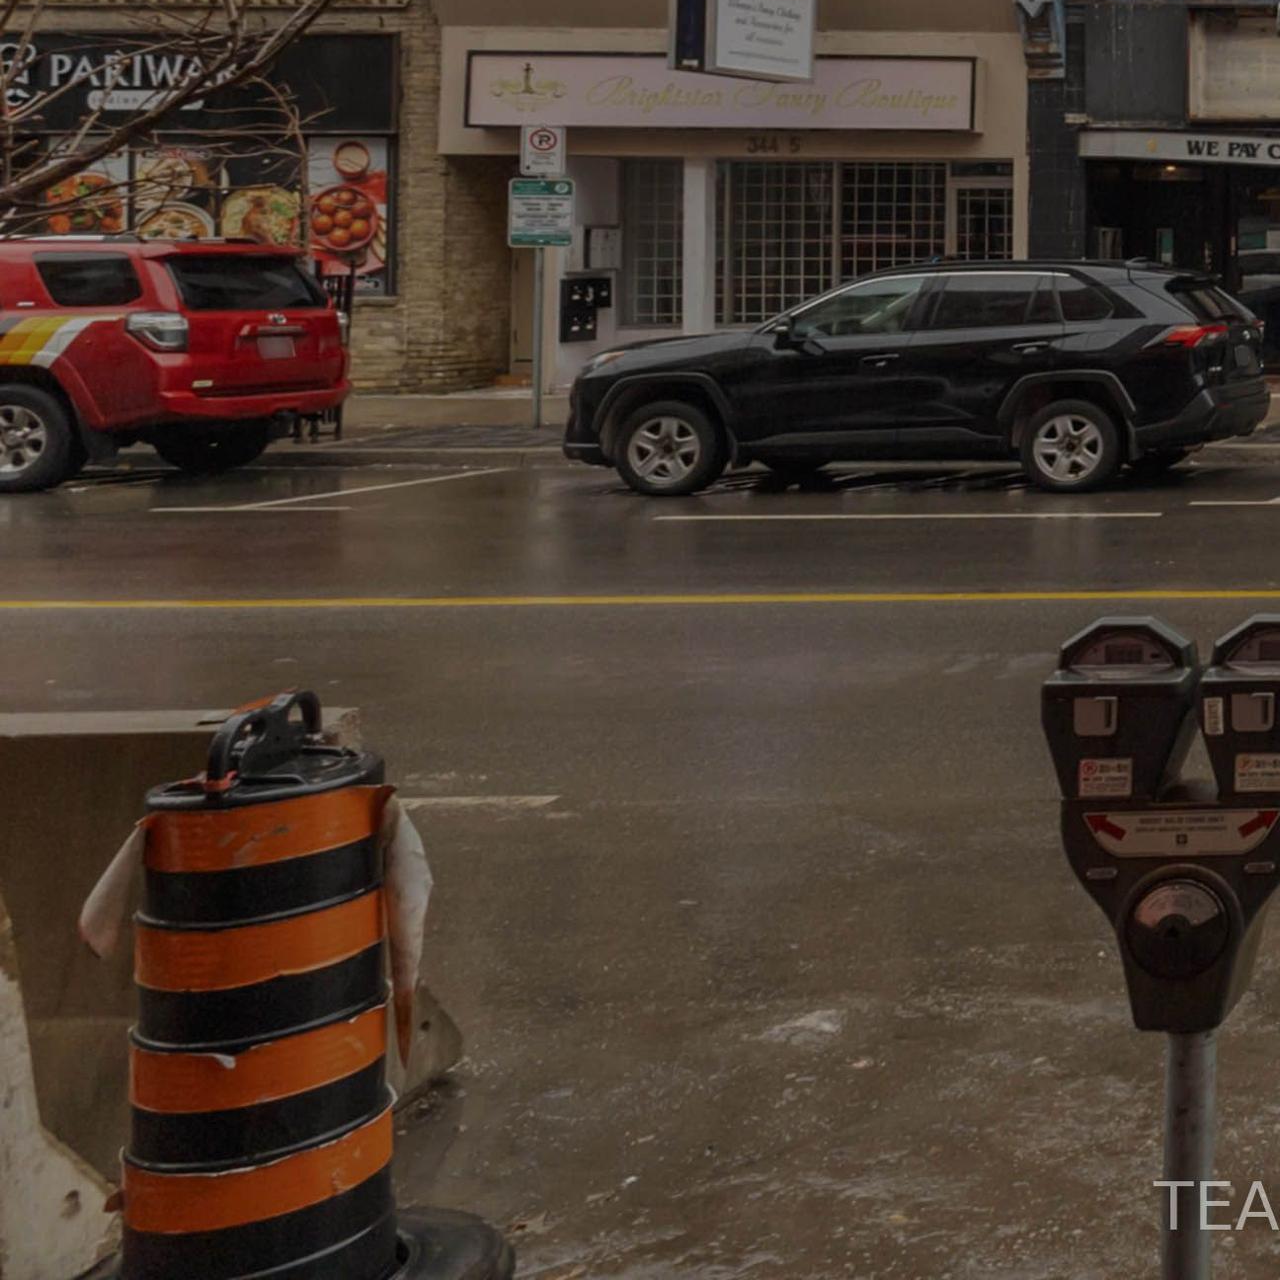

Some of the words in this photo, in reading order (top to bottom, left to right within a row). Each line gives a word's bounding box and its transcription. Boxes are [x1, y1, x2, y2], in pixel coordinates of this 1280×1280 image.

[834, 77, 959, 116] Boutique
[1187, 140, 1220, 157] WE
[1228, 142, 1261, 158] PAY
